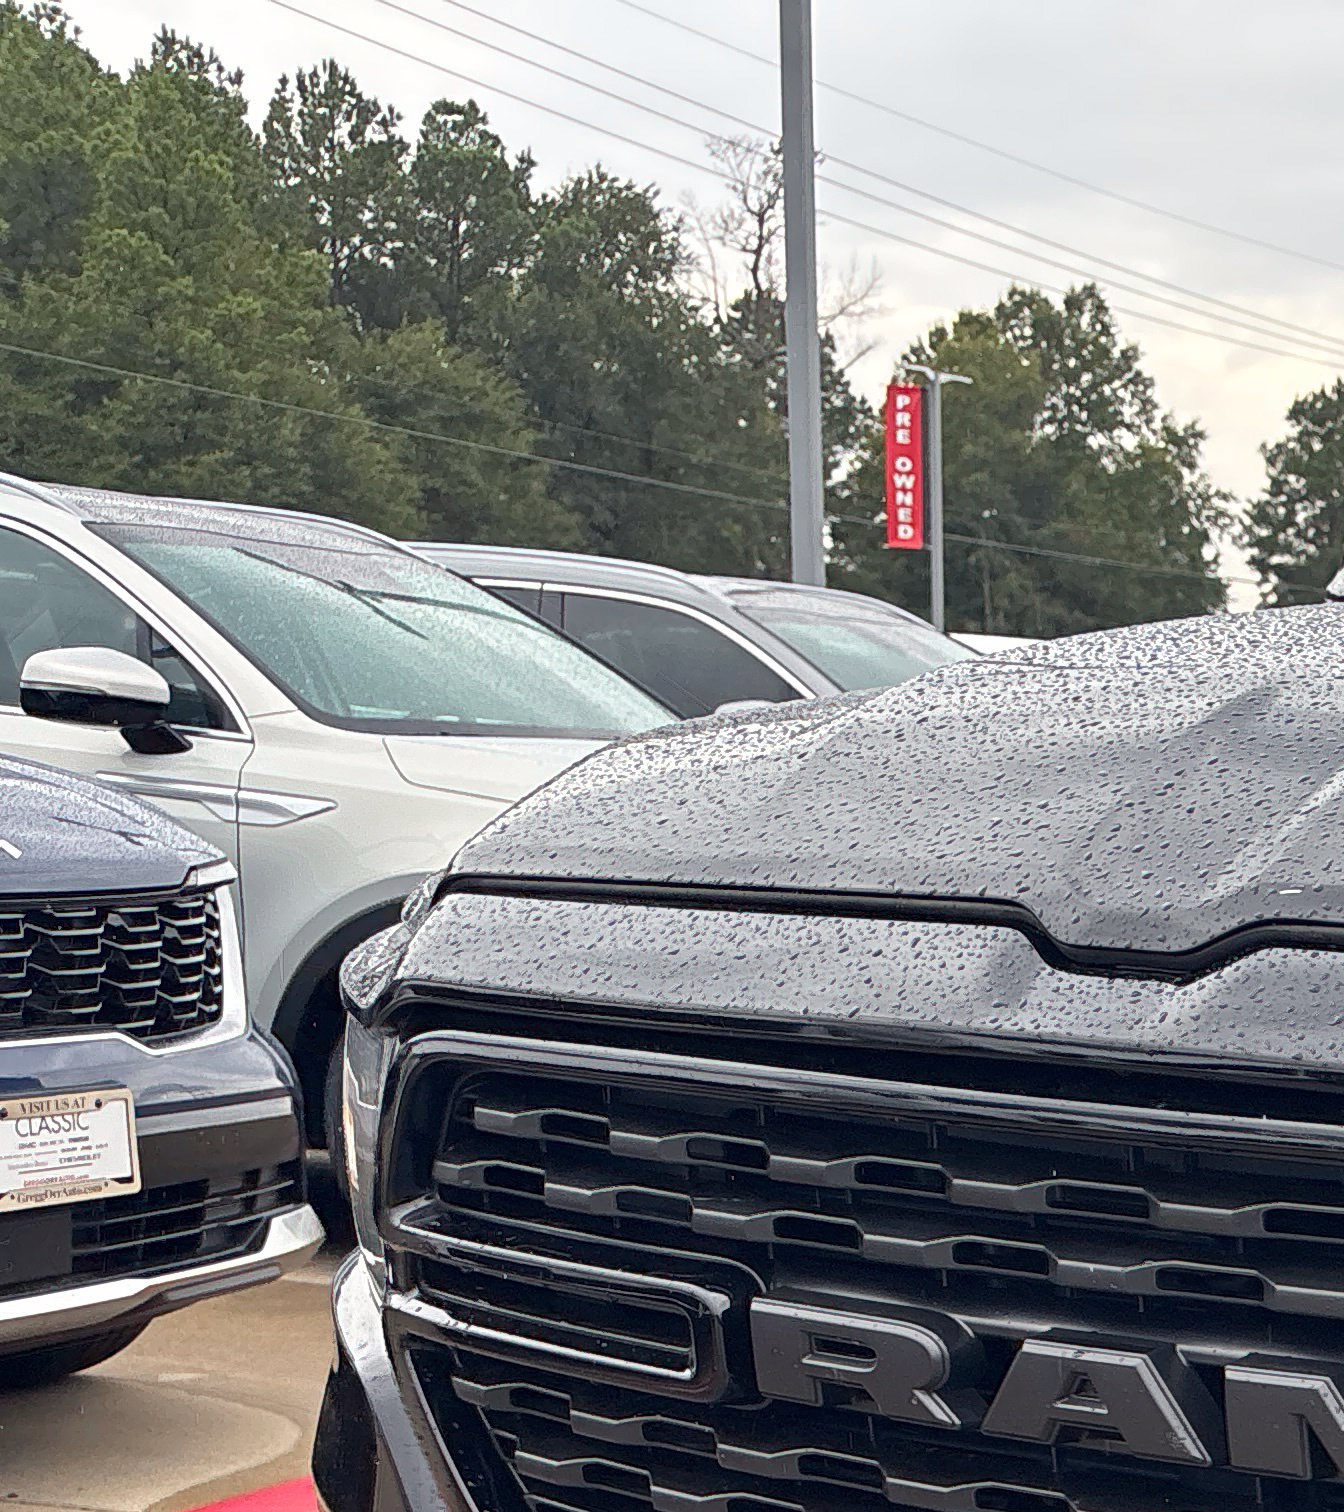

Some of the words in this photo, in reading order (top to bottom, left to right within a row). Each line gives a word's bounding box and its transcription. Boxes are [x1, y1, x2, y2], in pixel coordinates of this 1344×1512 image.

[895, 394, 911, 444] PRE
[893, 456, 915, 540] OWNED
[19, 1099, 52, 1114] VISIT
[54, 1098, 70, 1111] US
[71, 1096, 86, 1109] AT
[15, 1113, 89, 1137] CLASSIC
